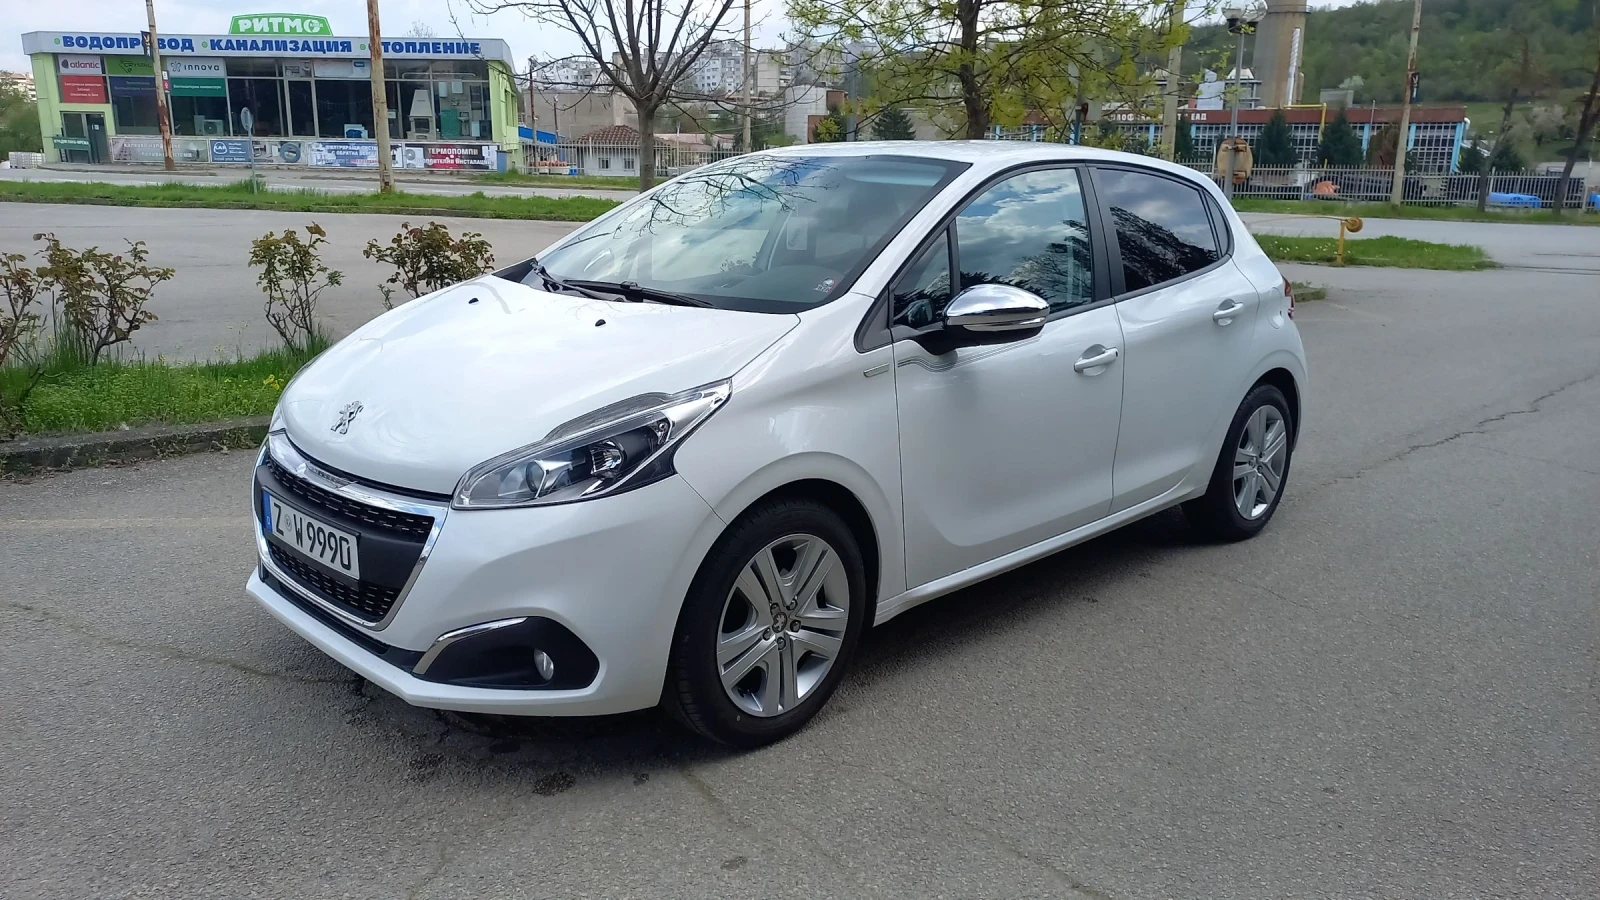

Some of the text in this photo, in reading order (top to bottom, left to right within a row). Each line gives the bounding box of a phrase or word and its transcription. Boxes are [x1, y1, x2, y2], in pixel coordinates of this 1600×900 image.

[238, 17, 323, 33] РИТМО
[62, 35, 195, 52] ВОДОПРВОД
[210, 39, 352, 54] КАНАЛИЗАЦИЯ
[368, 41, 481, 54] ТОПЛЕНИЕ
[69, 60, 100, 69] atlantic
[427, 147, 479, 155] ТЕРМОПОМПИ
[273, 502, 284, 537] Z
